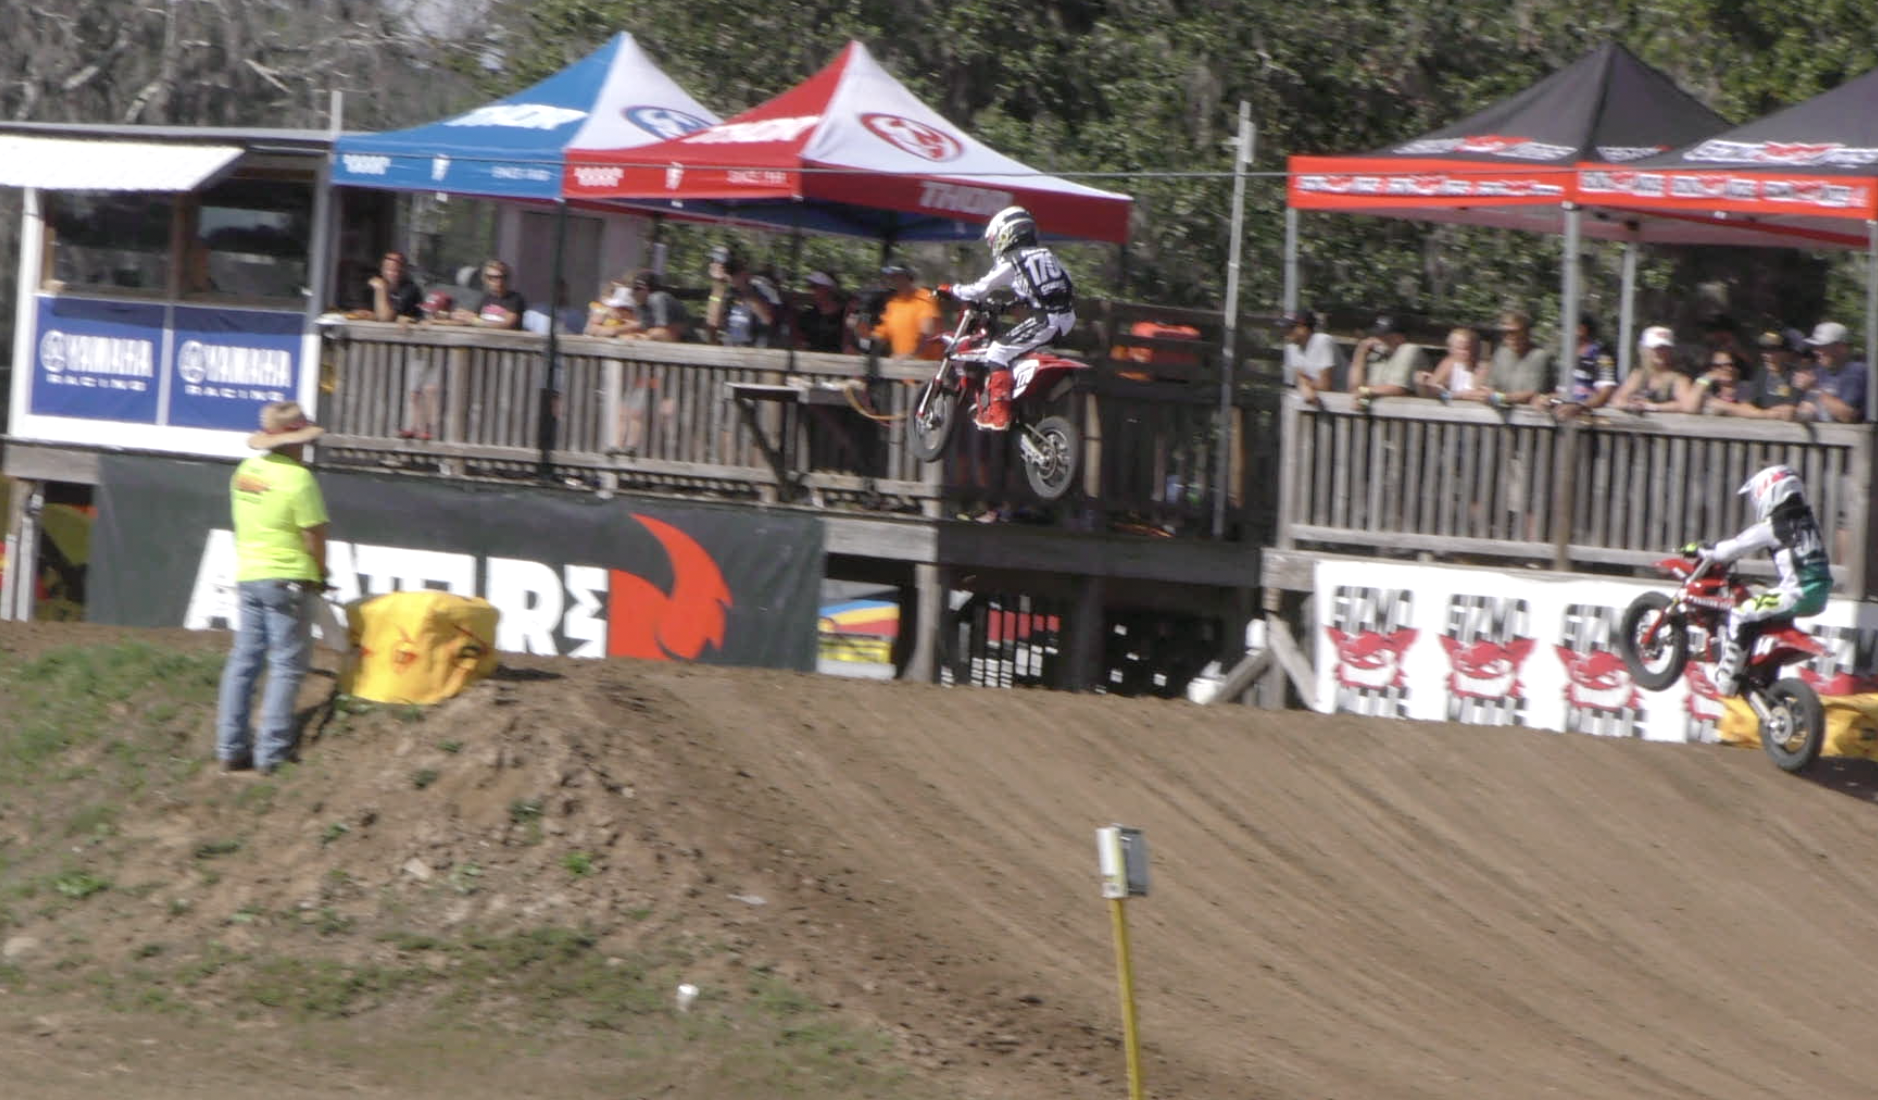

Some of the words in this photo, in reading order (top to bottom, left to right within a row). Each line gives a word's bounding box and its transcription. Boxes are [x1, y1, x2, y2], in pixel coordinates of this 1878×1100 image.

[64, 334, 153, 377] YAMAHA
[203, 345, 292, 387] YAMAHA
[46, 373, 148, 391] RACING
[185, 384, 285, 401] RACING
